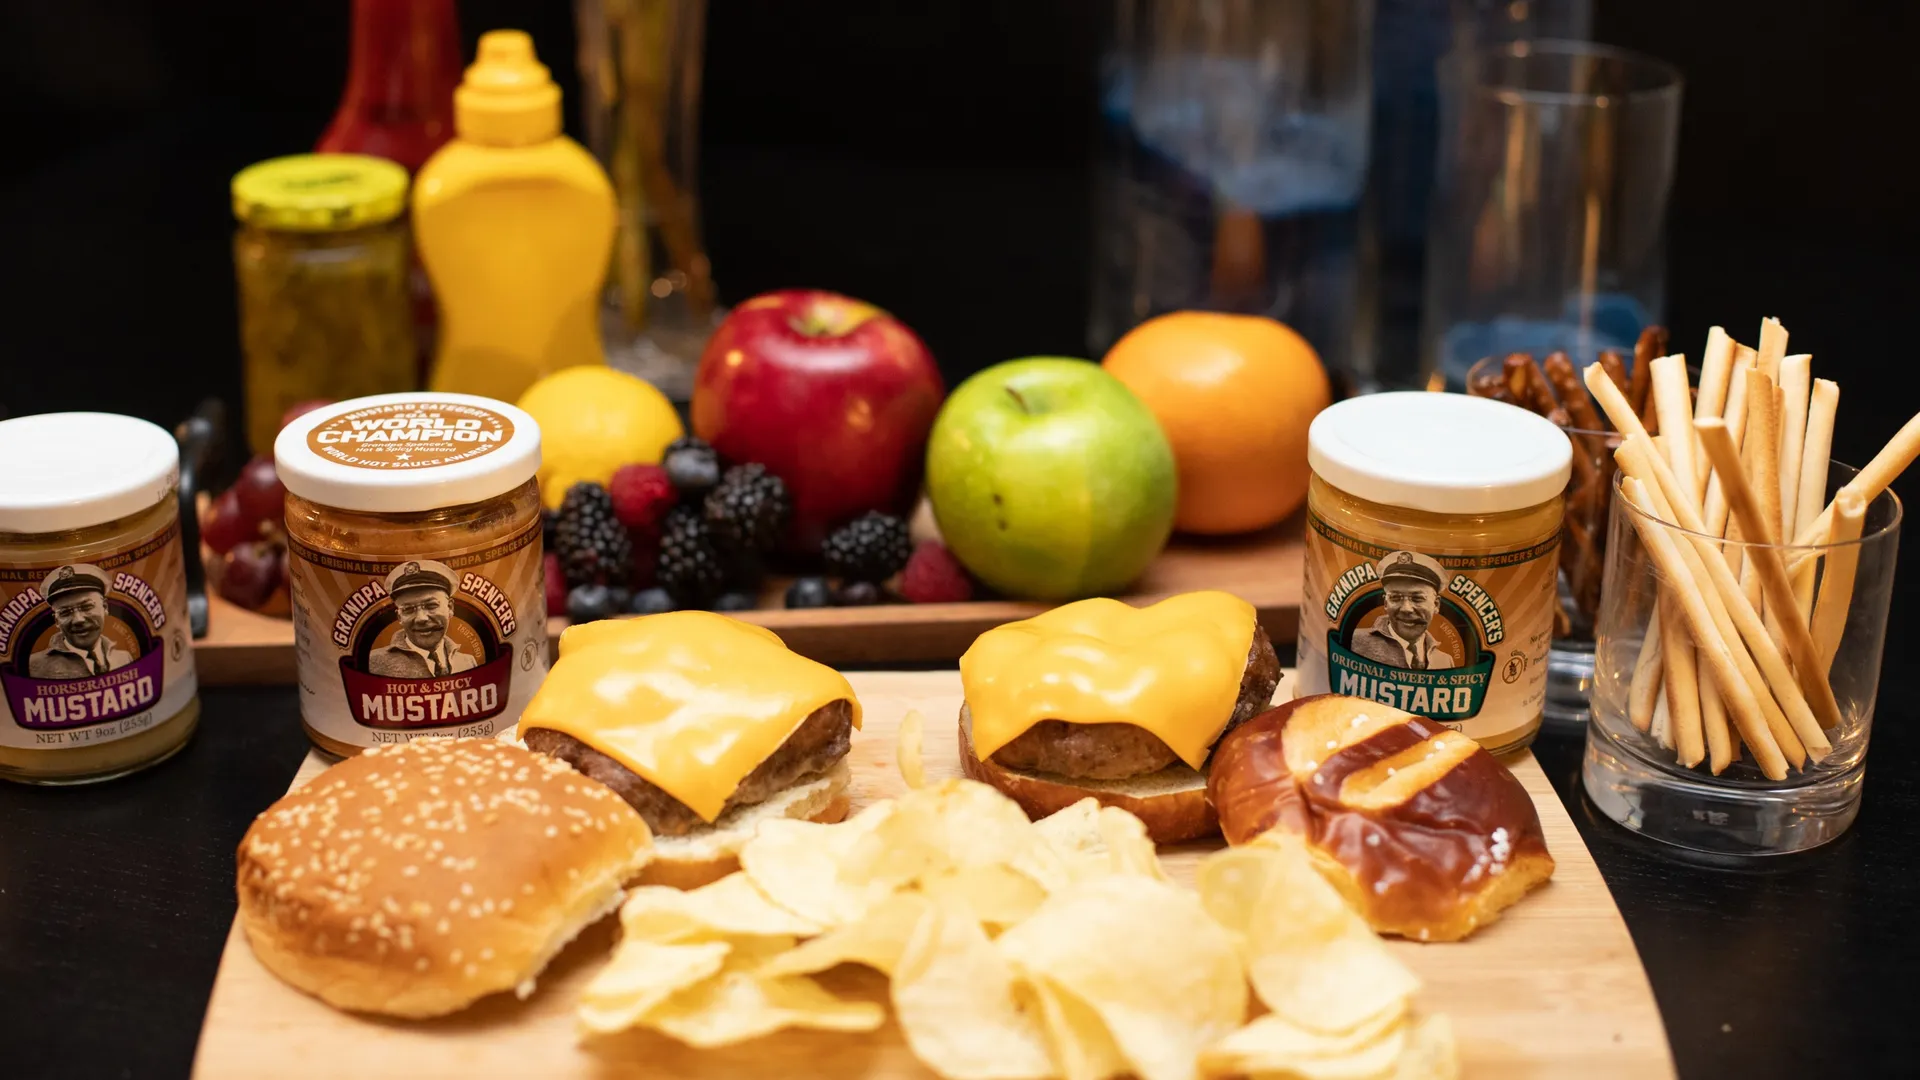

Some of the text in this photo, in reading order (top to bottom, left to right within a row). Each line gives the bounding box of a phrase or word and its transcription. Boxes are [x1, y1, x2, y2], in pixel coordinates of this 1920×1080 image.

[345, 403, 490, 420] MUSTARD CATEGORY
[316, 428, 503, 444] CHAMPION
[351, 418, 482, 430] WORLD
[321, 444, 494, 468] WORLD HOT SAUCE AWARDS
[361, 442, 404, 451] Grandpa
[385, 446, 412, 454] Spicy
[1326, 528, 1365, 553] ORIGINAL
[321, 556, 368, 573] ORIGINAL
[333, 573, 516, 645] GRANDPA SPENCER'S
[1326, 563, 1378, 619] GRANDPA
[1450, 574, 1503, 643] SPENCER'S
[1331, 652, 1487, 685] ORIGINAL SWEET & SPICY
[36, 667, 139, 696] HORSERADISH
[386, 677, 472, 694] HOT & SPICY
[1339, 668, 1472, 714] MUSTARD
[24, 675, 154, 723] MUSTARD
[361, 683, 498, 722] MUSTARD
[36, 732, 65, 744] NET
[68, 730, 92, 742] WT
[95, 728, 117, 738] 9oz
[372, 730, 402, 744] NET
[458, 720, 494, 739] (255g)
